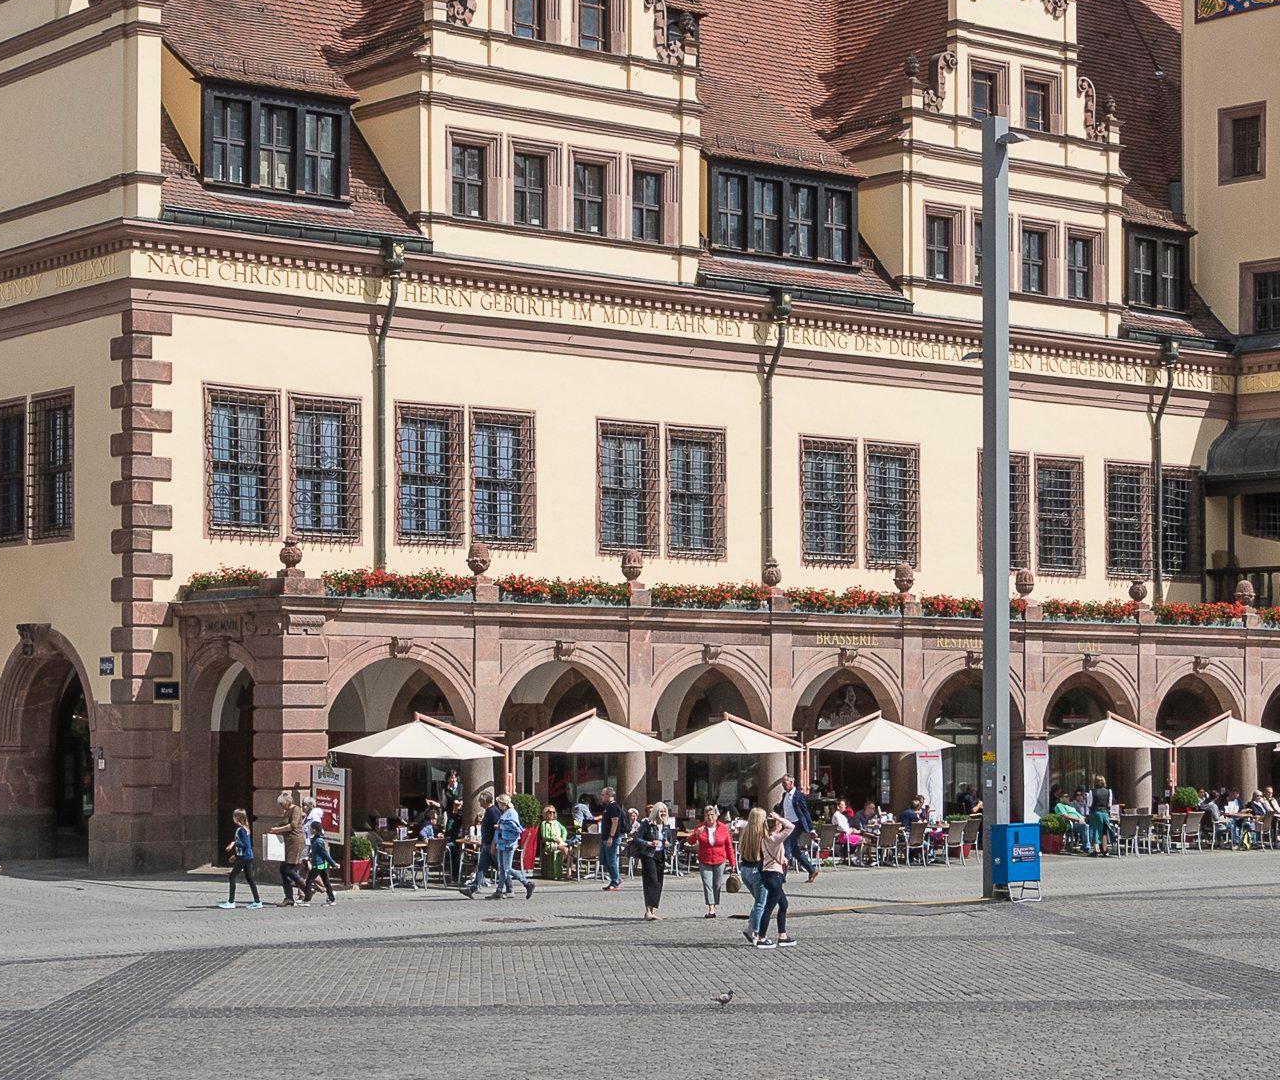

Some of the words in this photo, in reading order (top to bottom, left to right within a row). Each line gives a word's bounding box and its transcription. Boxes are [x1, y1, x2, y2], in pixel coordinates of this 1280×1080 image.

[147, 254, 210, 279] NACH
[404, 283, 472, 308] HERRN
[480, 293, 562, 318] GEBURTH
[571, 303, 592, 321] IM
[665, 315, 708, 334] IAHR
[716, 319, 742, 338] BEY
[854, 335, 881, 353] DES
[1040, 356, 1162, 384] HOCHGEBORENEN
[1170, 371, 1230, 392] URSTEN
[1243, 373, 1280, 392] UND
[816, 631, 879, 647] BRASSERIE
